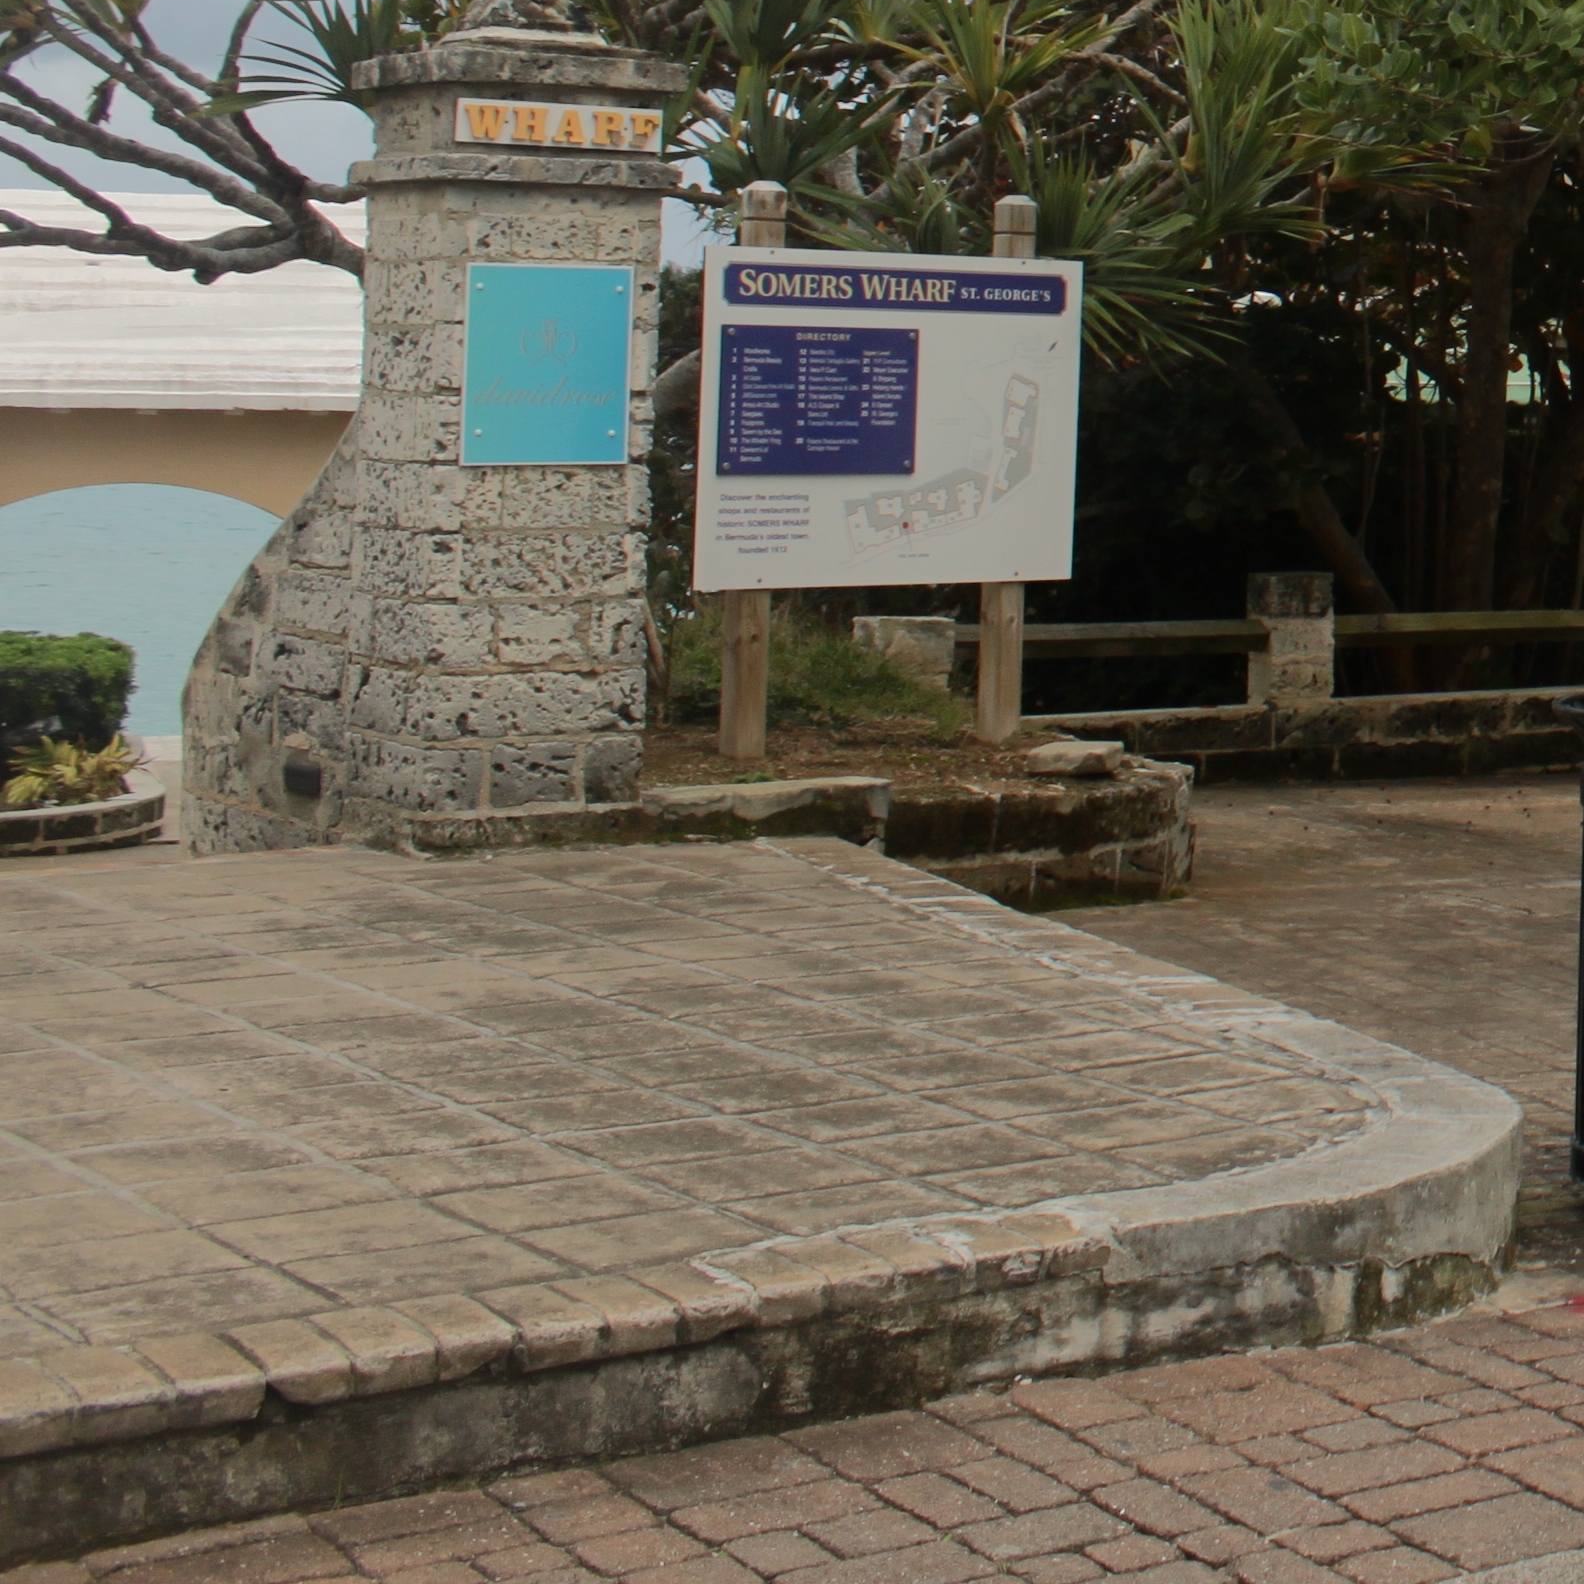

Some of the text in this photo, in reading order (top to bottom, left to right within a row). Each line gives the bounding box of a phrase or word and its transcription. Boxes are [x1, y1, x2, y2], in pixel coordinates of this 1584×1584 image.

[465, 104, 660, 148] WHARF
[739, 269, 1051, 303] SOMERS WHARF ST. GEORGE'S
[796, 333, 851, 341] DIRECTORY
